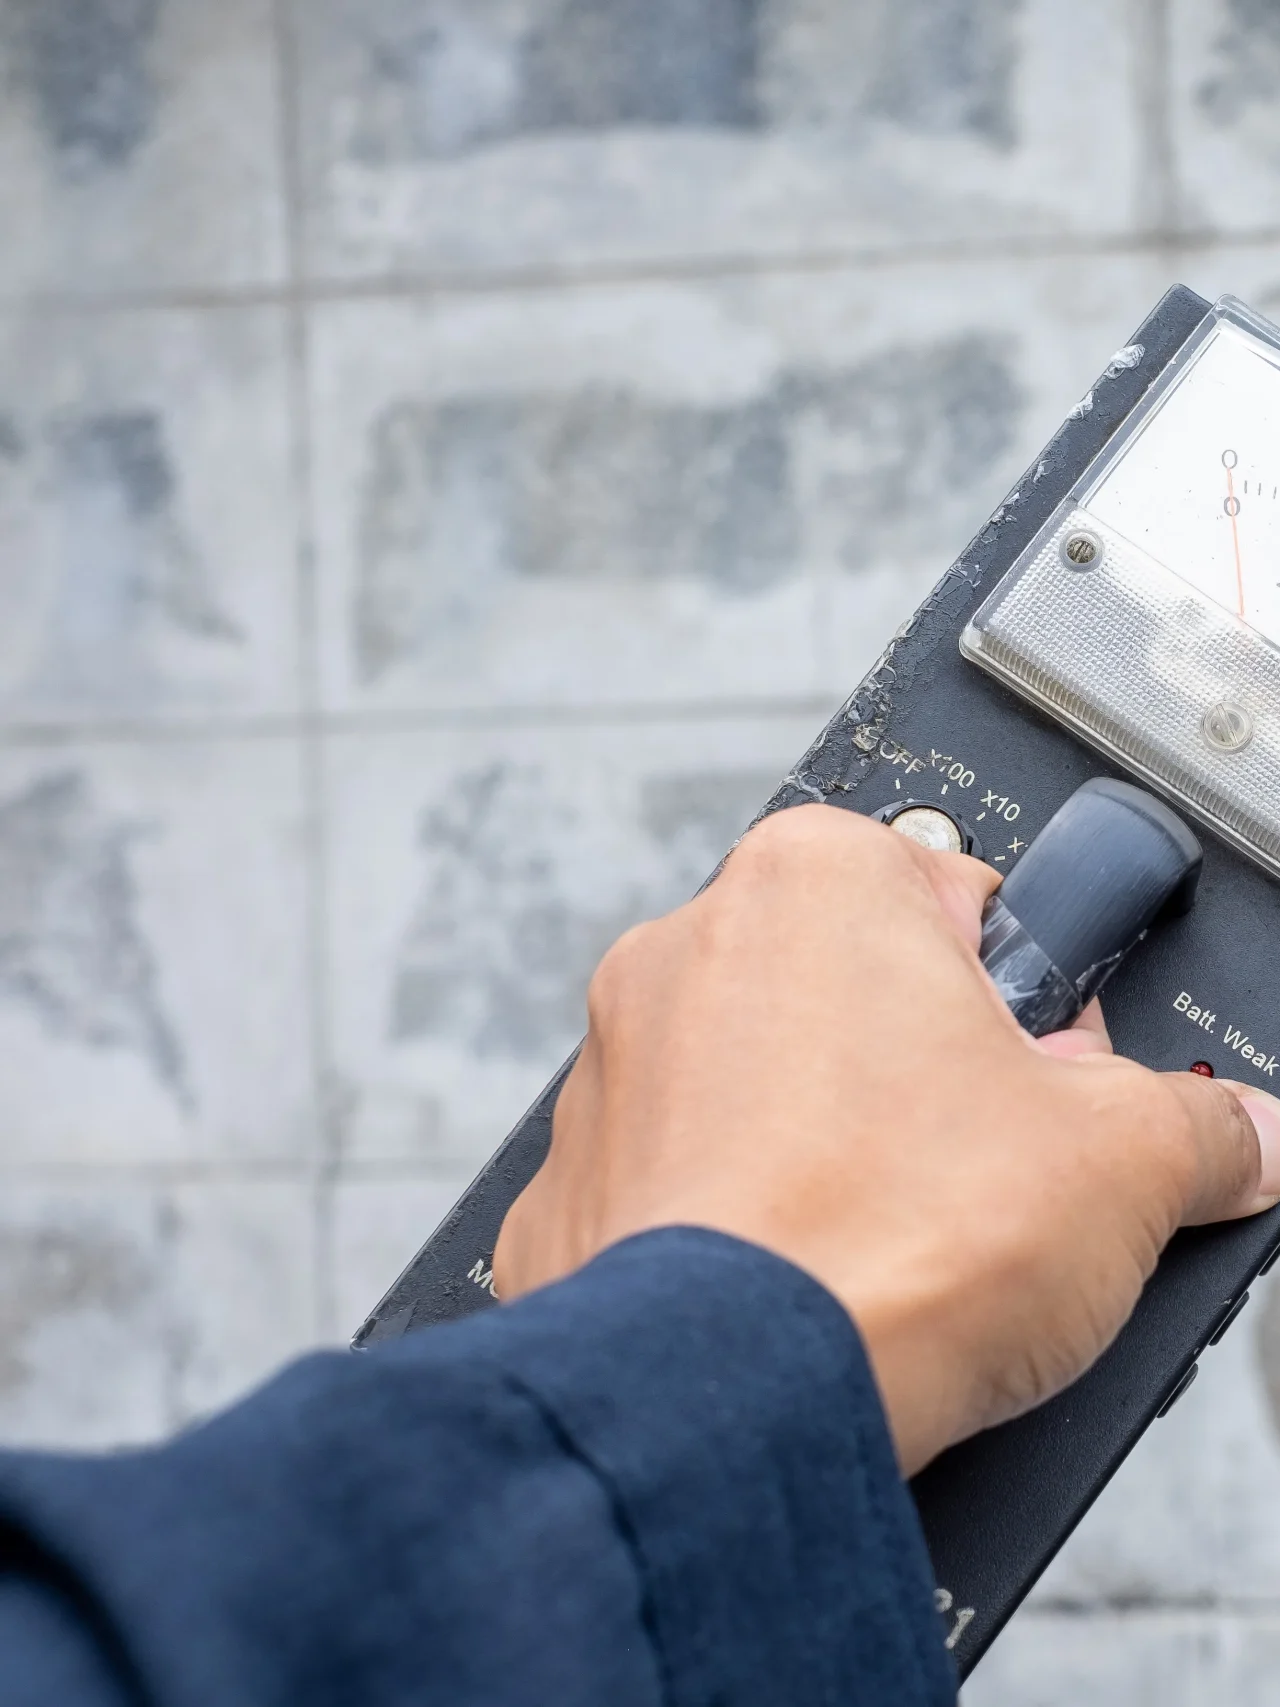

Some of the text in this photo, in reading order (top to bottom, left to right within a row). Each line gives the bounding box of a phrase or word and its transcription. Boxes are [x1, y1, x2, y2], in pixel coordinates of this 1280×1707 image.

[1220, 449, 1238, 469] 0
[1223, 496, 1241, 517] 0
[879, 741, 926, 774] OFF
[1172, 991, 1280, 1076] Batt. Weak
